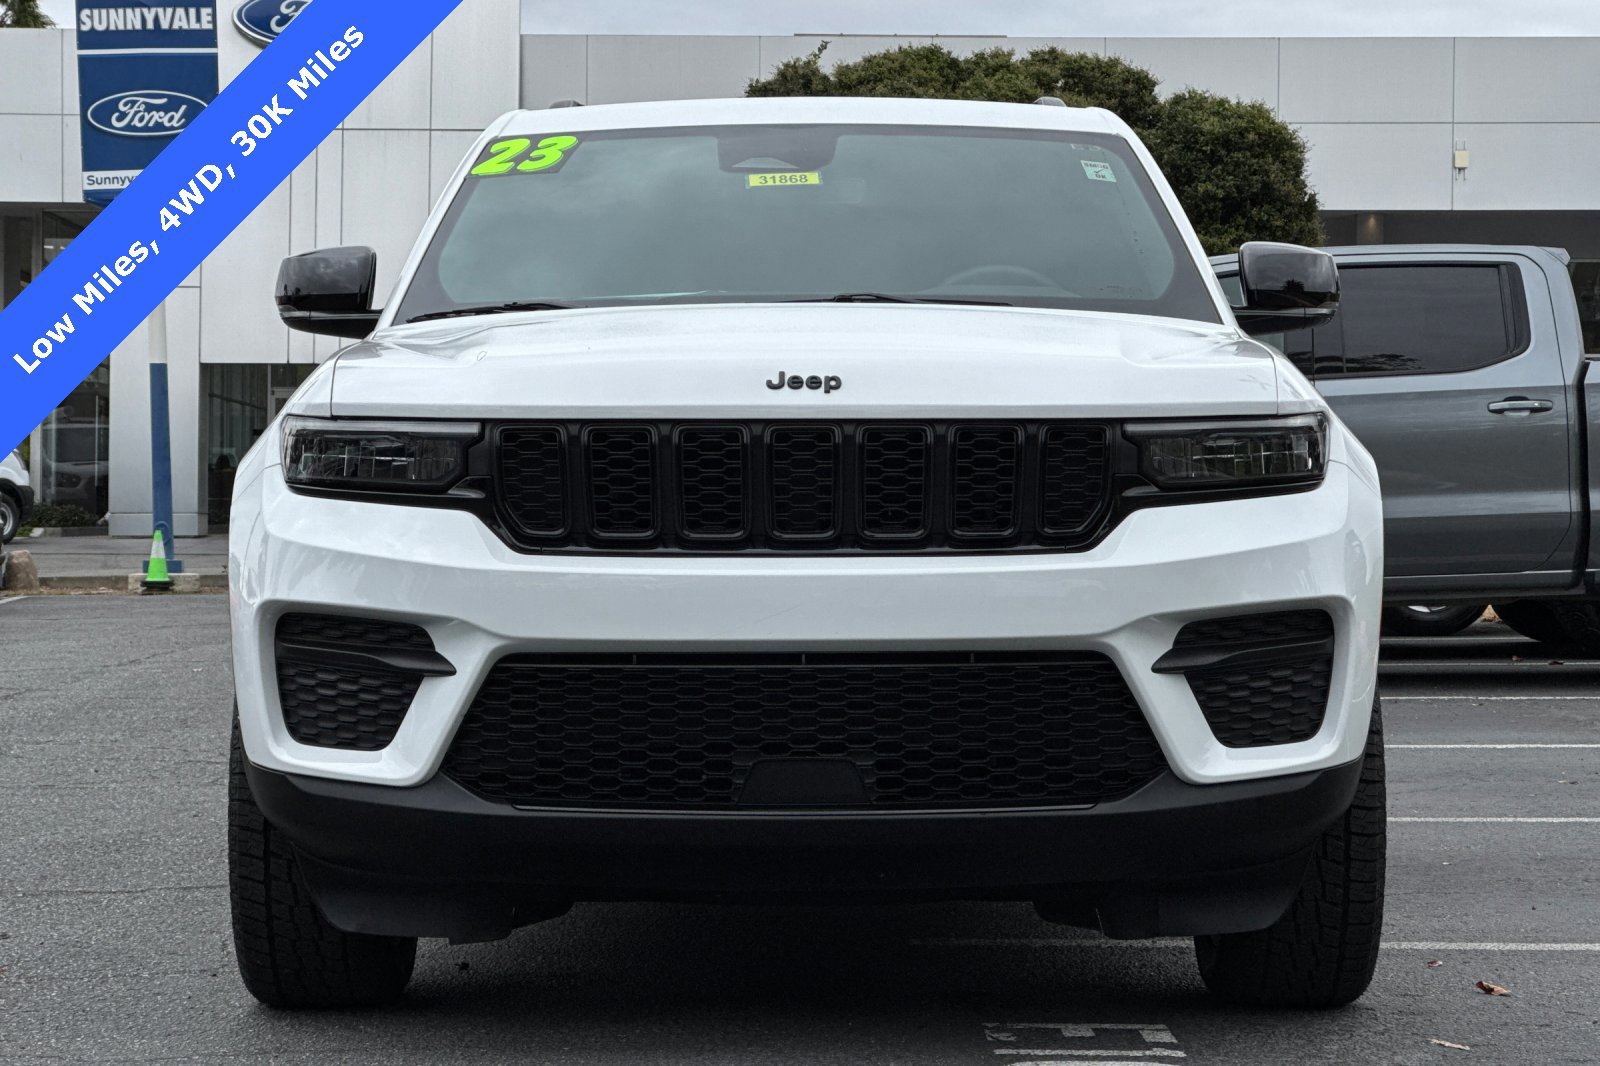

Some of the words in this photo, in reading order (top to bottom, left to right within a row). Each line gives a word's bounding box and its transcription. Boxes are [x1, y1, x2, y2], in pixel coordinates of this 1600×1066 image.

[80, 7, 213, 31] SUNNYVALE
[111, 97, 187, 127] Ford
[471, 135, 579, 176] 23
[86, 175, 134, 186] Sunnyv
[759, 174, 808, 185] 31868
[765, 370, 842, 394] Jeep
